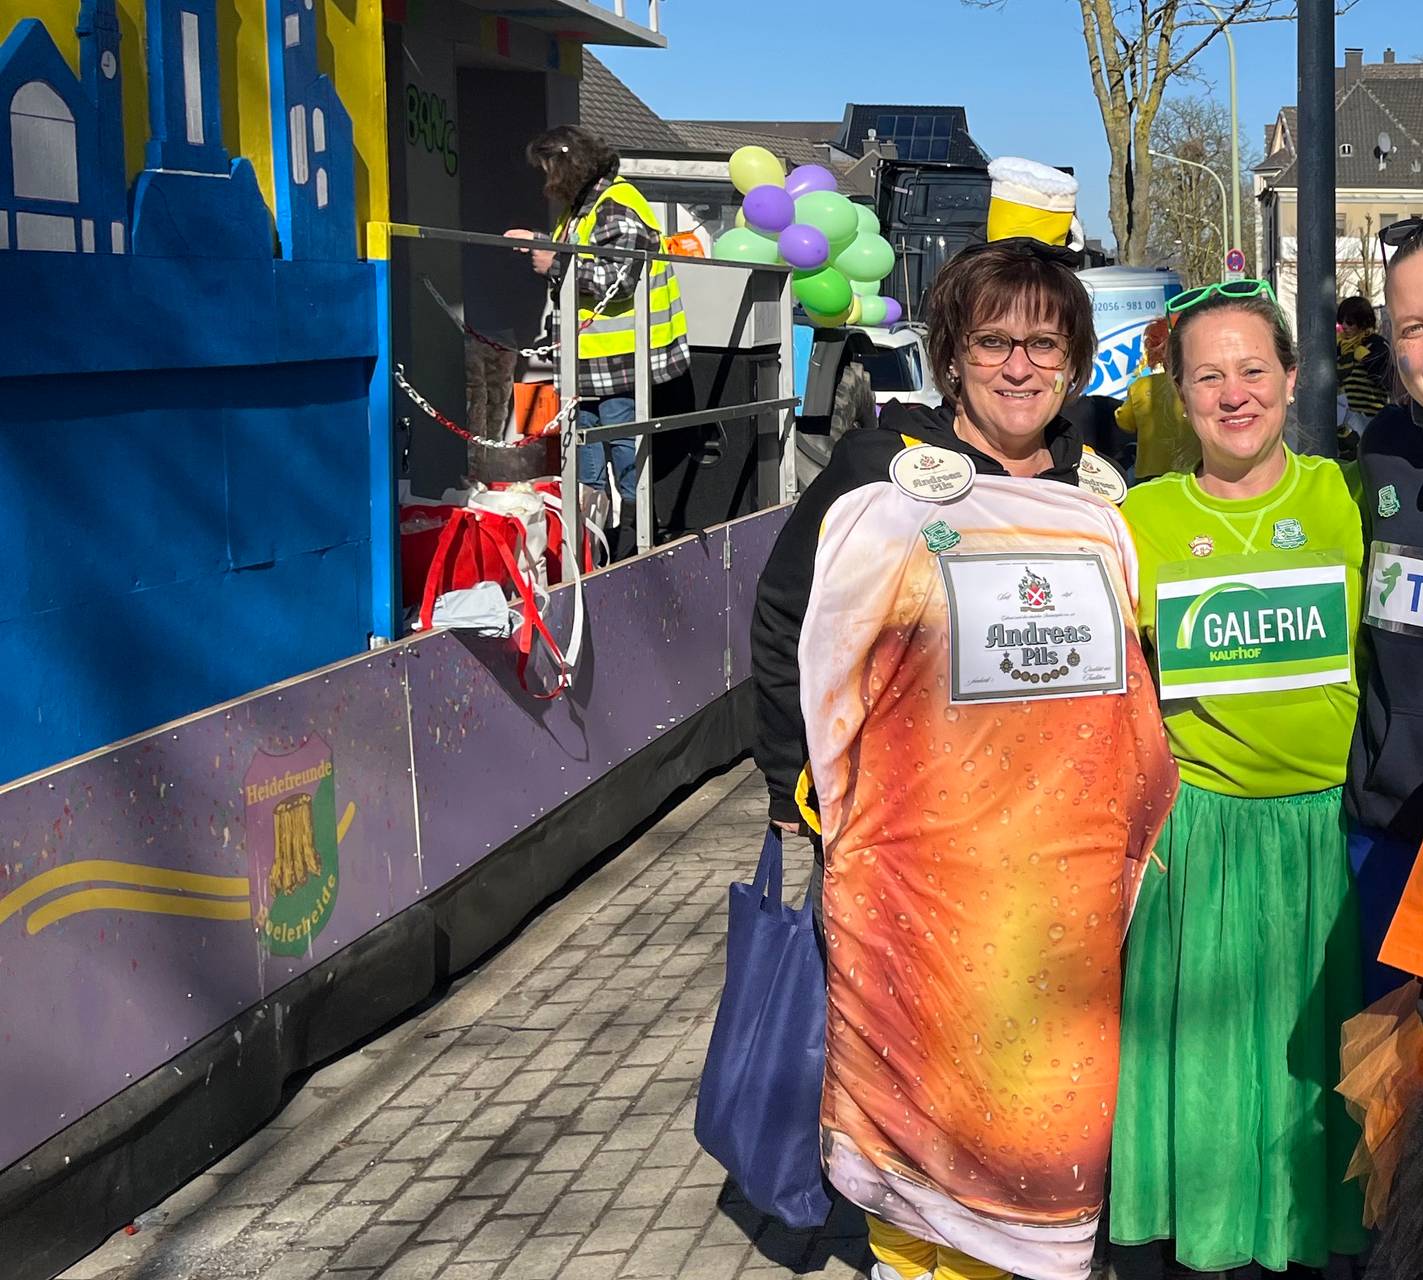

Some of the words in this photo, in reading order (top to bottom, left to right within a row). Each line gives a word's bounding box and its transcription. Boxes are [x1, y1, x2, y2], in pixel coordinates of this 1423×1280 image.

[406, 84, 458, 177] BANG
[1126, 301, 1142, 311] 981
[1145, 300, 1156, 310] 00
[912, 471, 962, 488] Andreas
[930, 482, 954, 492] Pils
[985, 621, 1092, 648] Andreas
[1204, 605, 1326, 648] GALERIA
[1021, 647, 1059, 667] Pils
[246, 760, 333, 807] Heidefreunde
